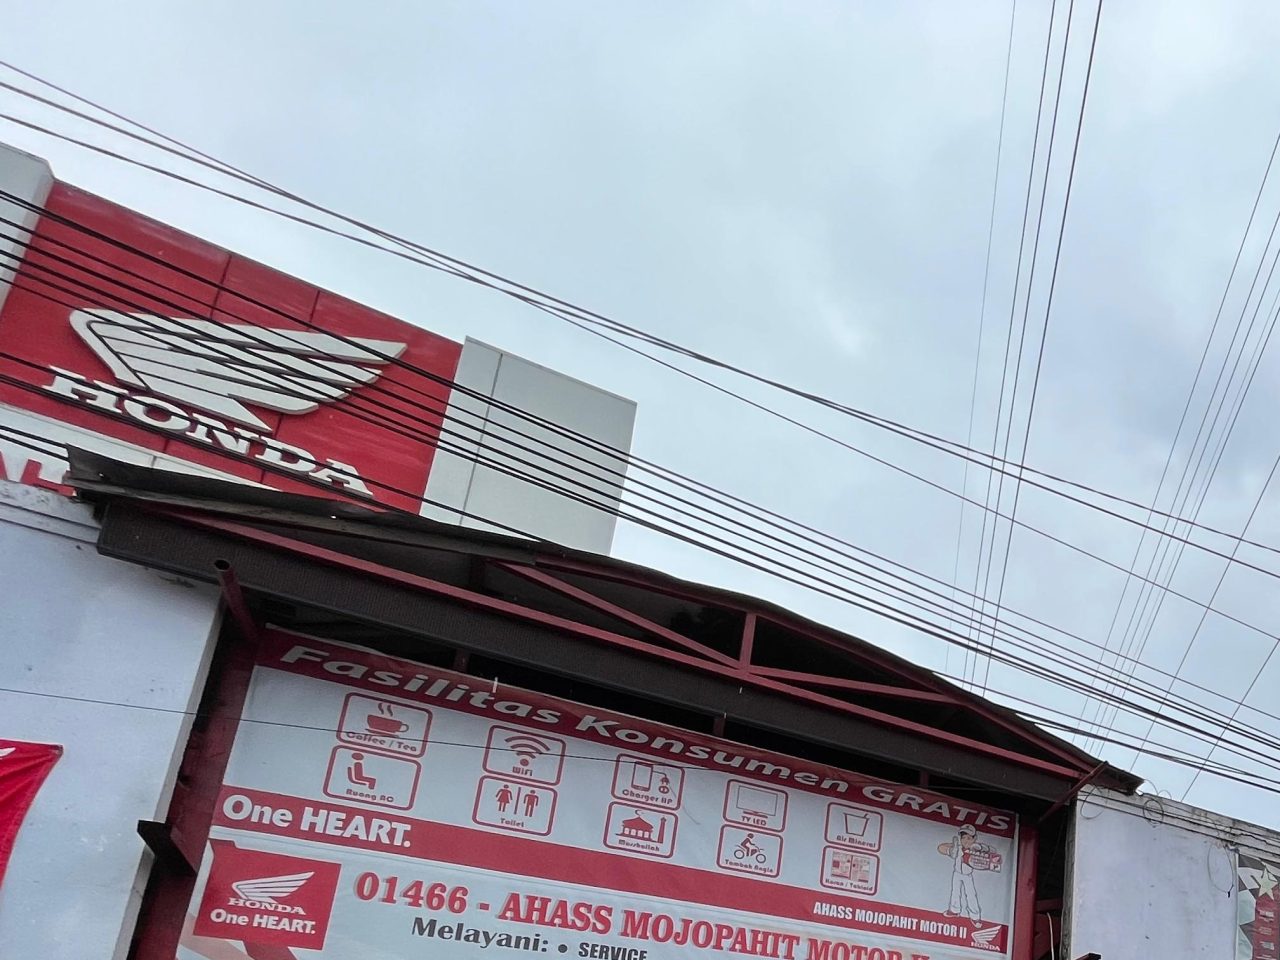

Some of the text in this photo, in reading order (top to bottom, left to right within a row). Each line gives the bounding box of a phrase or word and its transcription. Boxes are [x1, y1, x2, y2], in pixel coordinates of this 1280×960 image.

[42, 367, 374, 497] HONDA
[281, 646, 1011, 831] Fasilitas Konsumen GRATIS
[346, 731, 386, 745] Coffee
[396, 741, 417, 752] Tea
[622, 789, 659, 802] Charger
[223, 794, 412, 849] One HEART.
[500, 818, 524, 827] Toilet
[752, 817, 767, 826] LED
[848, 837, 876, 848] Mineral
[228, 897, 306, 915] HONDA
[354, 871, 470, 914] 01466
[499, 891, 613, 936] AHASS
[620, 908, 801, 960] MOJOPAHIT
[210, 908, 316, 935] One HEART.
[813, 901, 853, 919] AHASS
[855, 907, 918, 931] MOJOPAHIT
[919, 917, 956, 938] MOTOR
[411, 917, 549, 953] Melayani:
[970, 941, 1001, 953] HONDA
